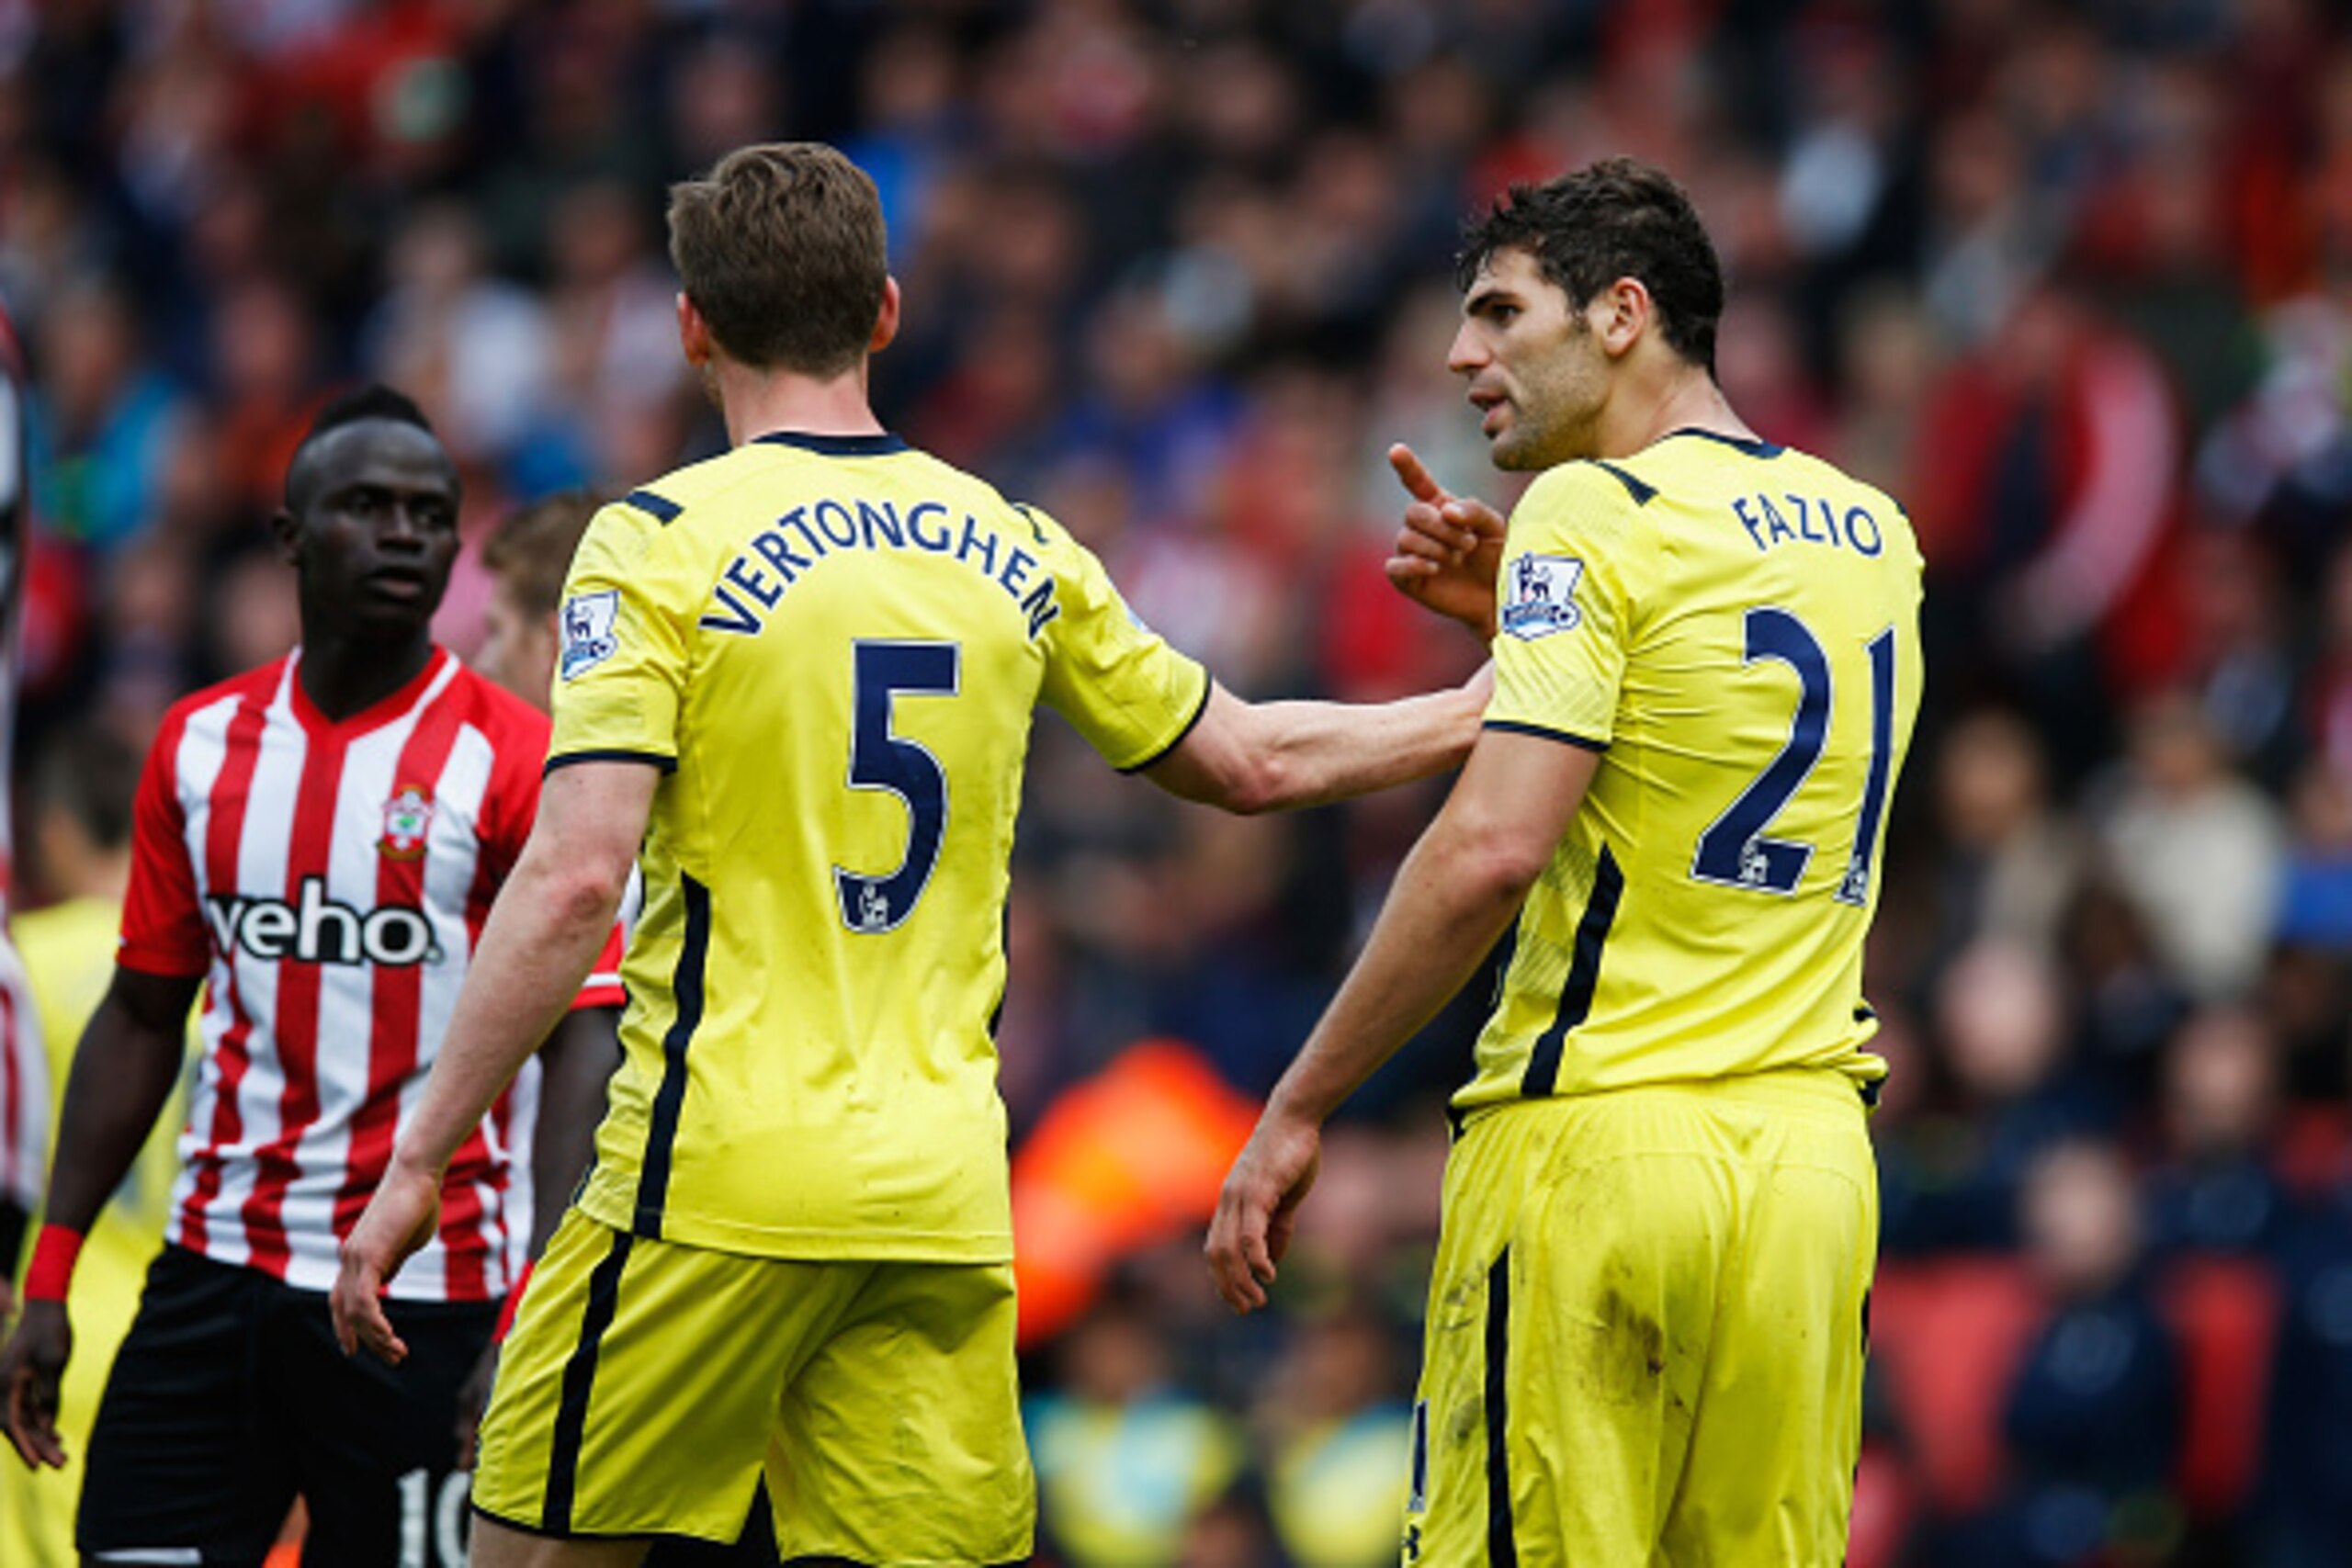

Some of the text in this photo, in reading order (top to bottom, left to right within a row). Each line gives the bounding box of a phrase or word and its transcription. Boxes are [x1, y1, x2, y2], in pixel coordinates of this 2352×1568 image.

[698, 498, 1060, 639] VERTONGHEN
[1732, 492, 1883, 558] FAZIO
[832, 637, 961, 934] 5
[1689, 605, 1895, 907] 21
